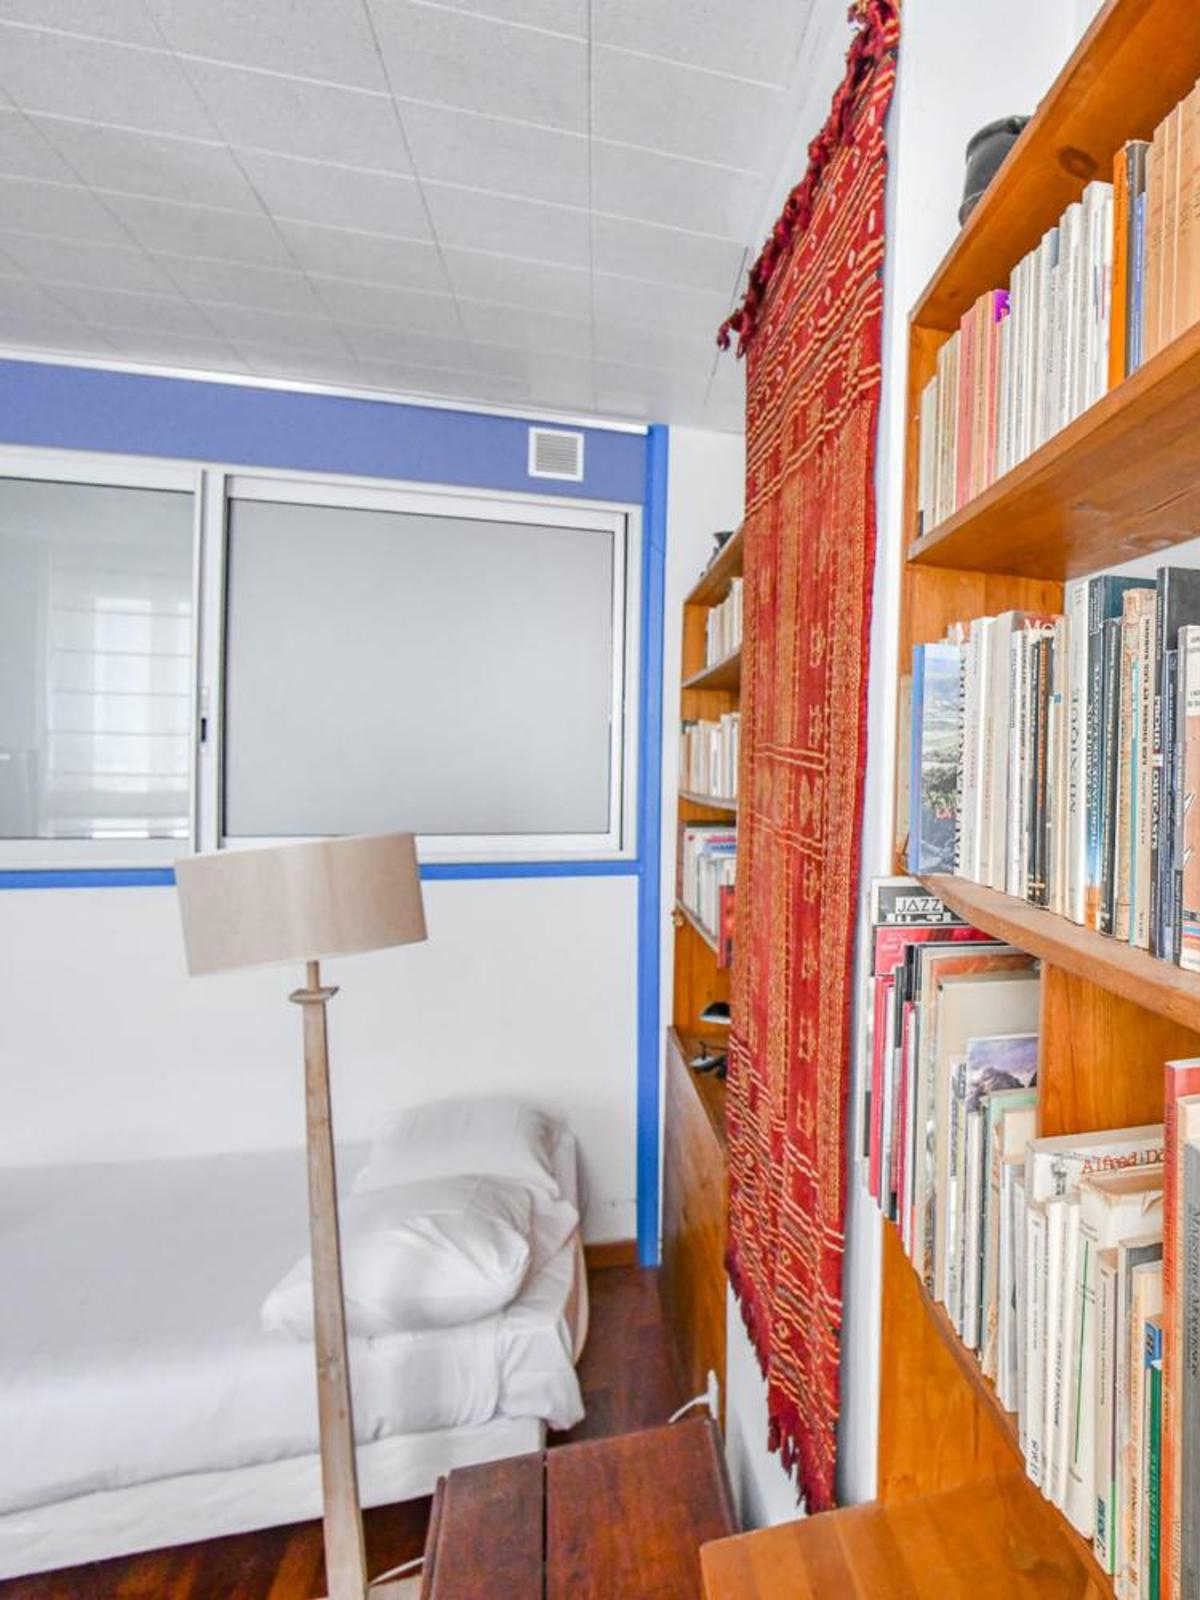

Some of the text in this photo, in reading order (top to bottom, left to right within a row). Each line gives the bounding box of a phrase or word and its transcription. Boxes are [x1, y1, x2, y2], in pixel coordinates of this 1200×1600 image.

[1069, 688, 1079, 814] MEXIQUE
[897, 898, 941, 913] JAZZ
[1081, 1151, 1138, 1174] Alfred
